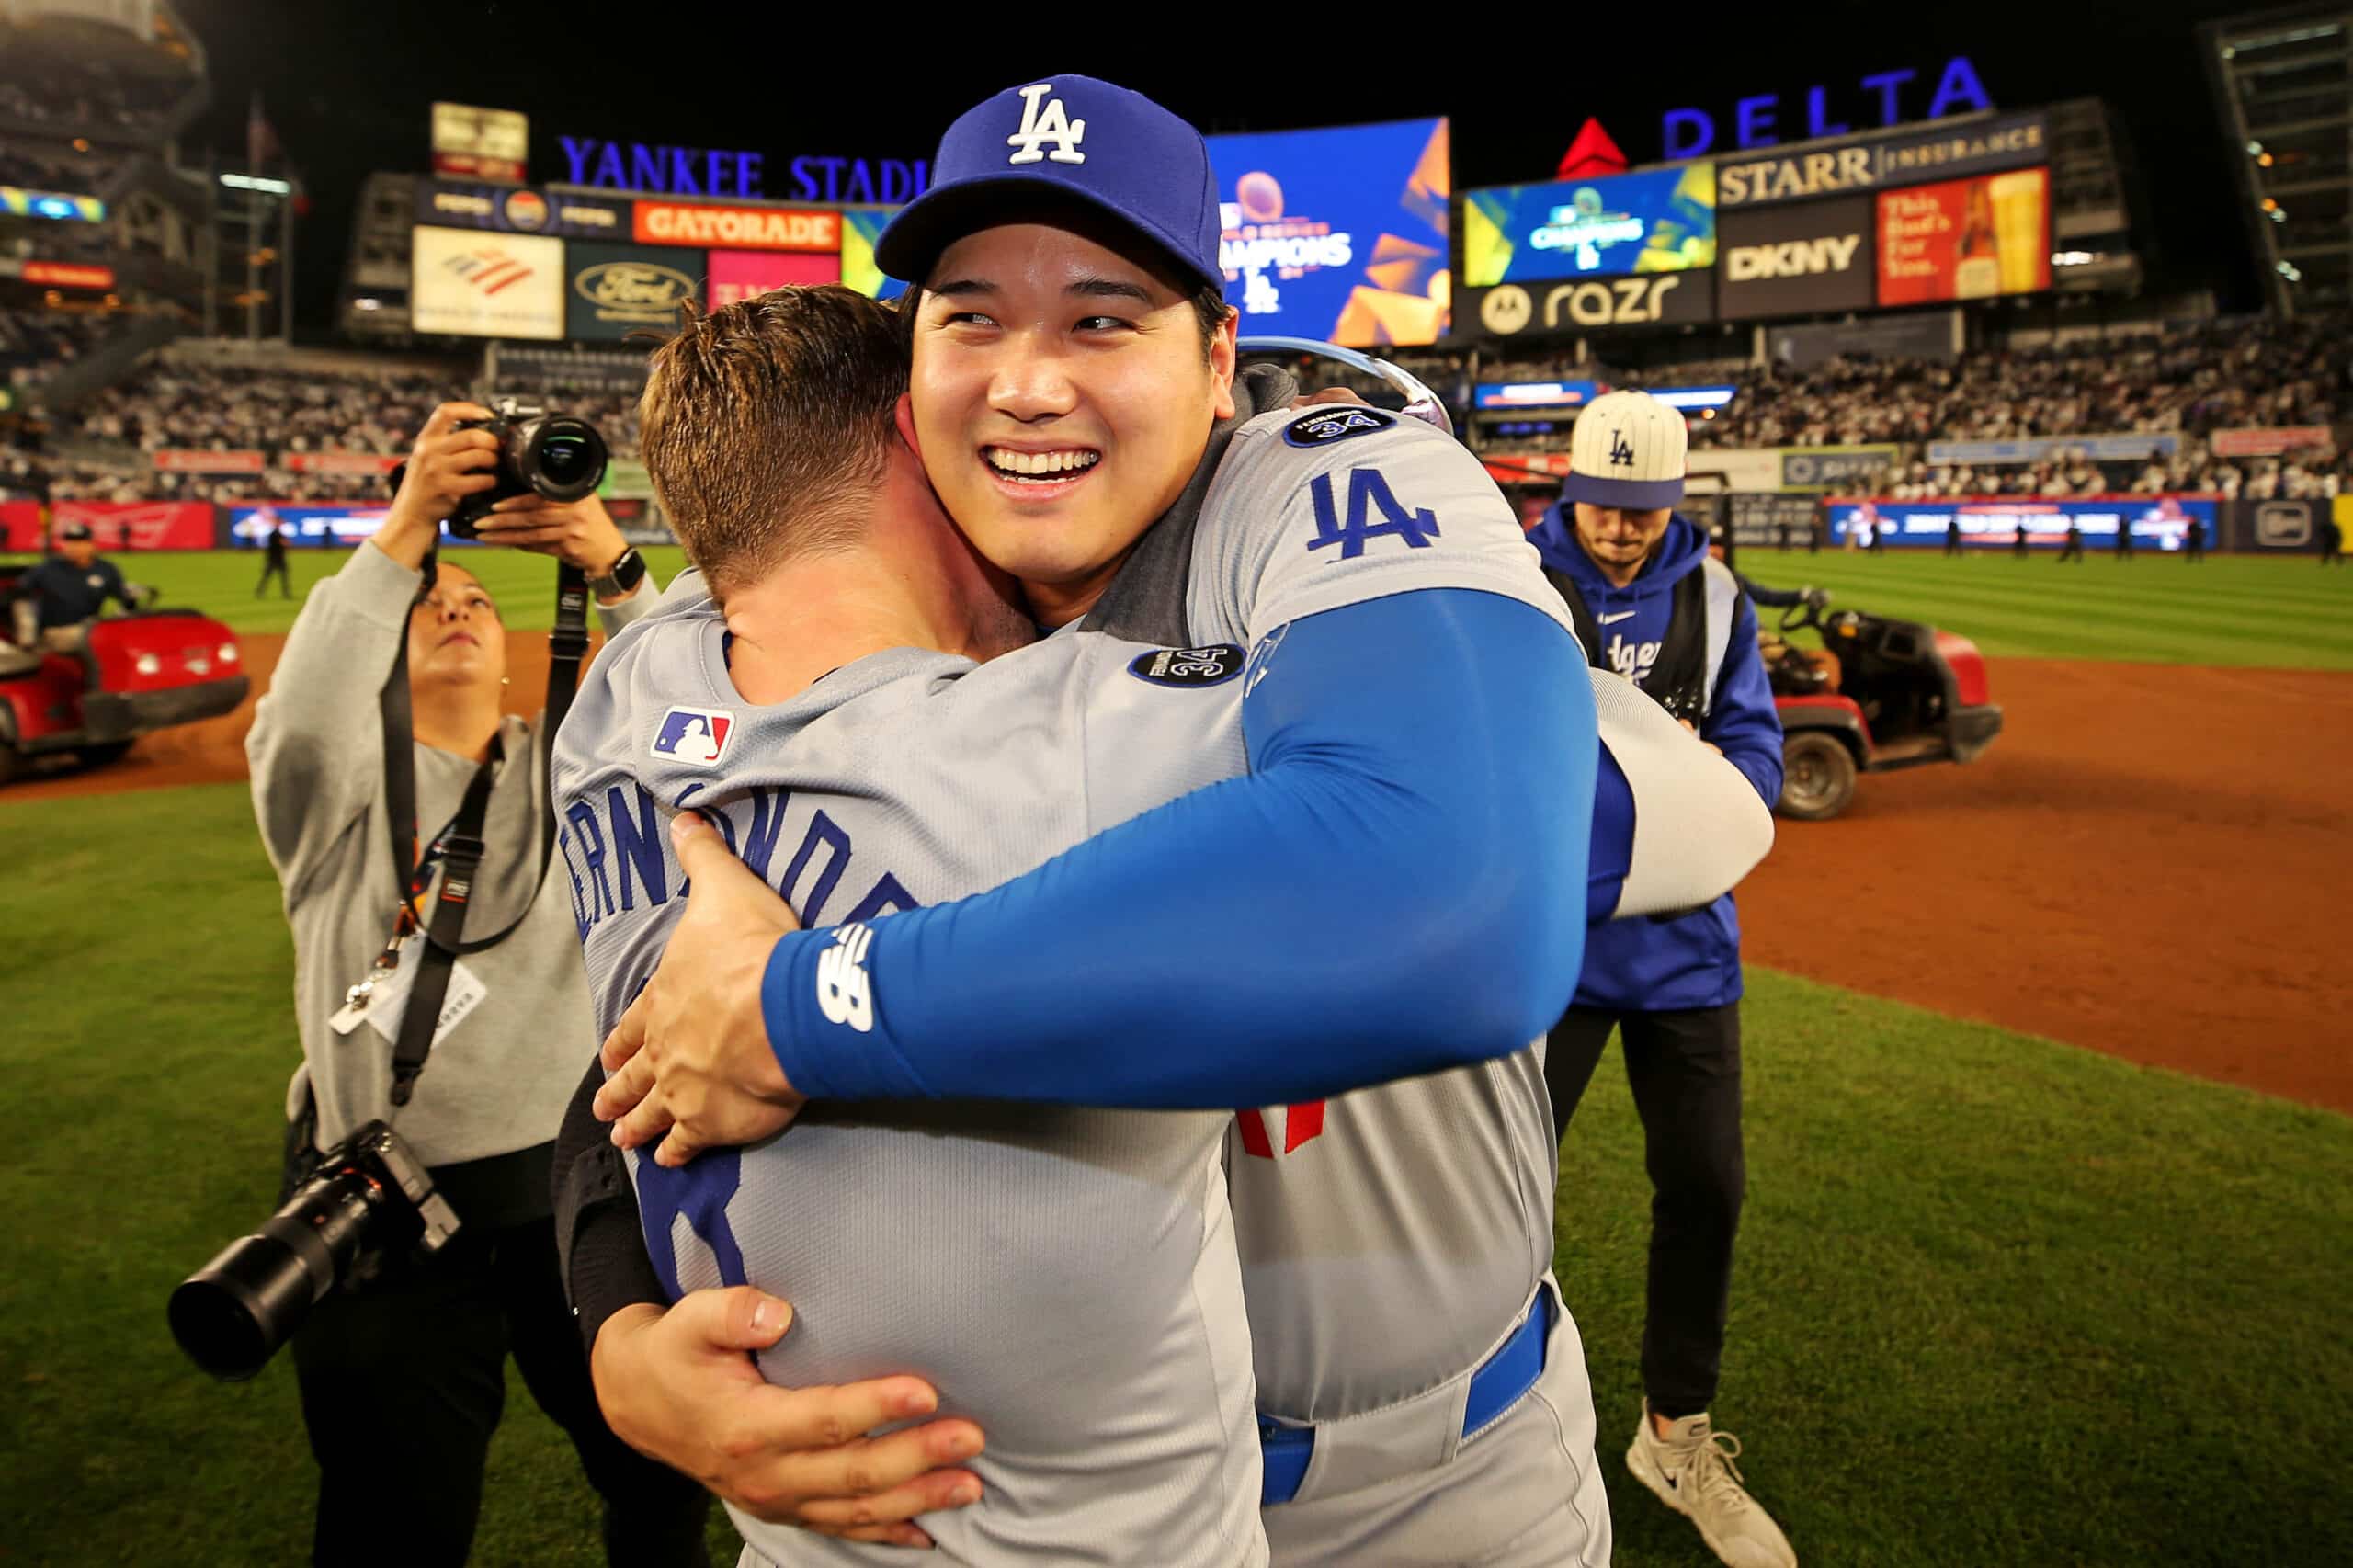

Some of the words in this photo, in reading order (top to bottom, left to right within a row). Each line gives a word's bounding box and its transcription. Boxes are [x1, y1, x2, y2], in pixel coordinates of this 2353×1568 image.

[1007, 84, 1086, 165] LA
[1663, 55, 1991, 161] DELTA
[557, 135, 764, 199] YANKEE
[1720, 147, 1874, 205] STARR
[1886, 125, 2042, 173] INSURANCE
[646, 209, 834, 245] GATORADE
[1728, 234, 1860, 281] DKNY
[596, 264, 676, 303] Ford
[1544, 275, 1680, 328] razr
[1307, 414, 1381, 438] 34
[1609, 429, 1634, 466] LA
[1306, 467, 1441, 563] LA
[1169, 648, 1228, 677] 34
